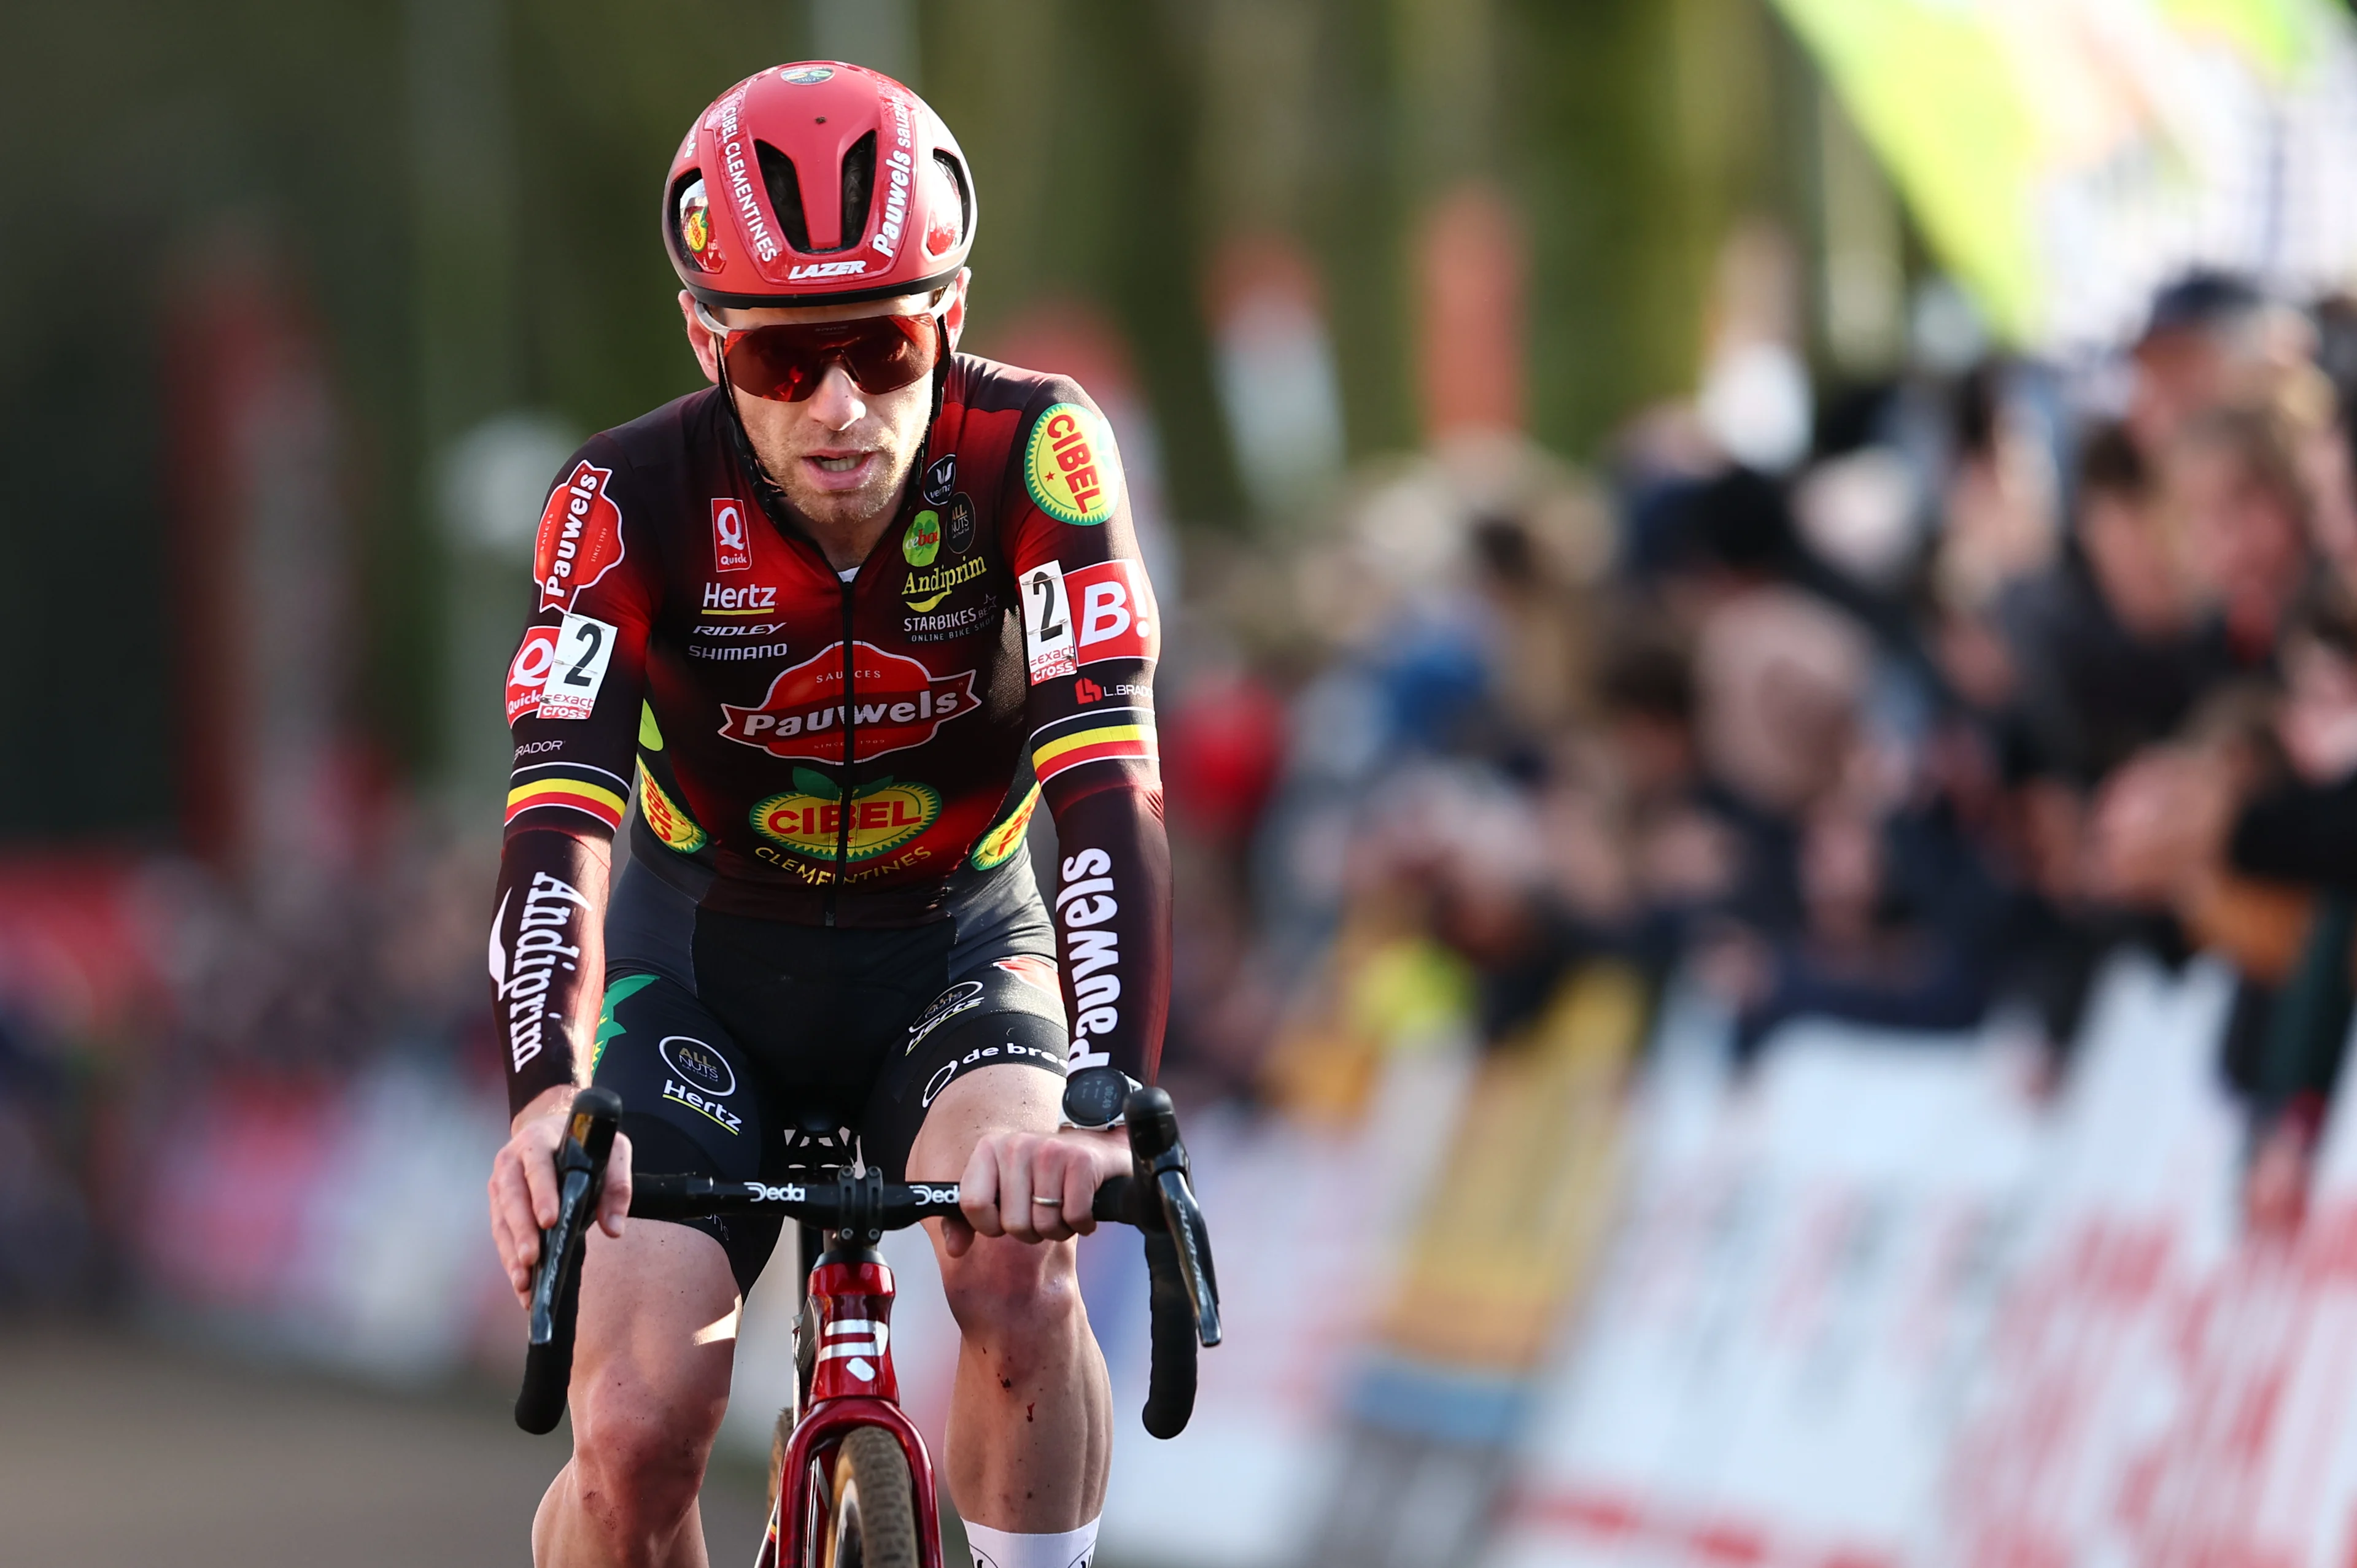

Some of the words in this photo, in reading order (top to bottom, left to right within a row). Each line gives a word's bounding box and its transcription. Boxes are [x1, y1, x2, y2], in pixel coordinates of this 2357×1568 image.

[722, 107, 738, 144] CIBEL
[725, 142, 778, 262] CLEMENTINES
[873, 150, 911, 258] Pauwels
[788, 260, 867, 280] LAZER
[1047, 414, 1101, 514] CIBEL
[545, 473, 598, 598] Pauwels
[721, 553, 747, 566] Quick
[901, 555, 987, 595] Andiprim
[702, 582, 777, 608] Hertz
[1032, 571, 1063, 643] 2
[693, 622, 788, 636] RIDLEY
[911, 633, 945, 643] ONLINE
[948, 627, 970, 639] BIKE
[563, 623, 602, 687] 2
[688, 643, 788, 661] SHIMANO
[816, 670, 882, 684] SAUCES
[1033, 660, 1074, 682] cross
[508, 689, 542, 716] Quick
[543, 706, 587, 719] cross
[743, 690, 959, 737] Pauwels
[768, 800, 922, 835] CIBEL
[755, 846, 932, 886] CLEMENTINES
[498, 871, 593, 1073] Andiprim
[1056, 848, 1121, 1077] Pauwels
[679, 1054, 718, 1079] NUTS
[962, 1046, 1000, 1064] de
[664, 1079, 742, 1132] Hertz
[743, 1182, 805, 1202] Deda
[908, 1184, 961, 1205] Ded
